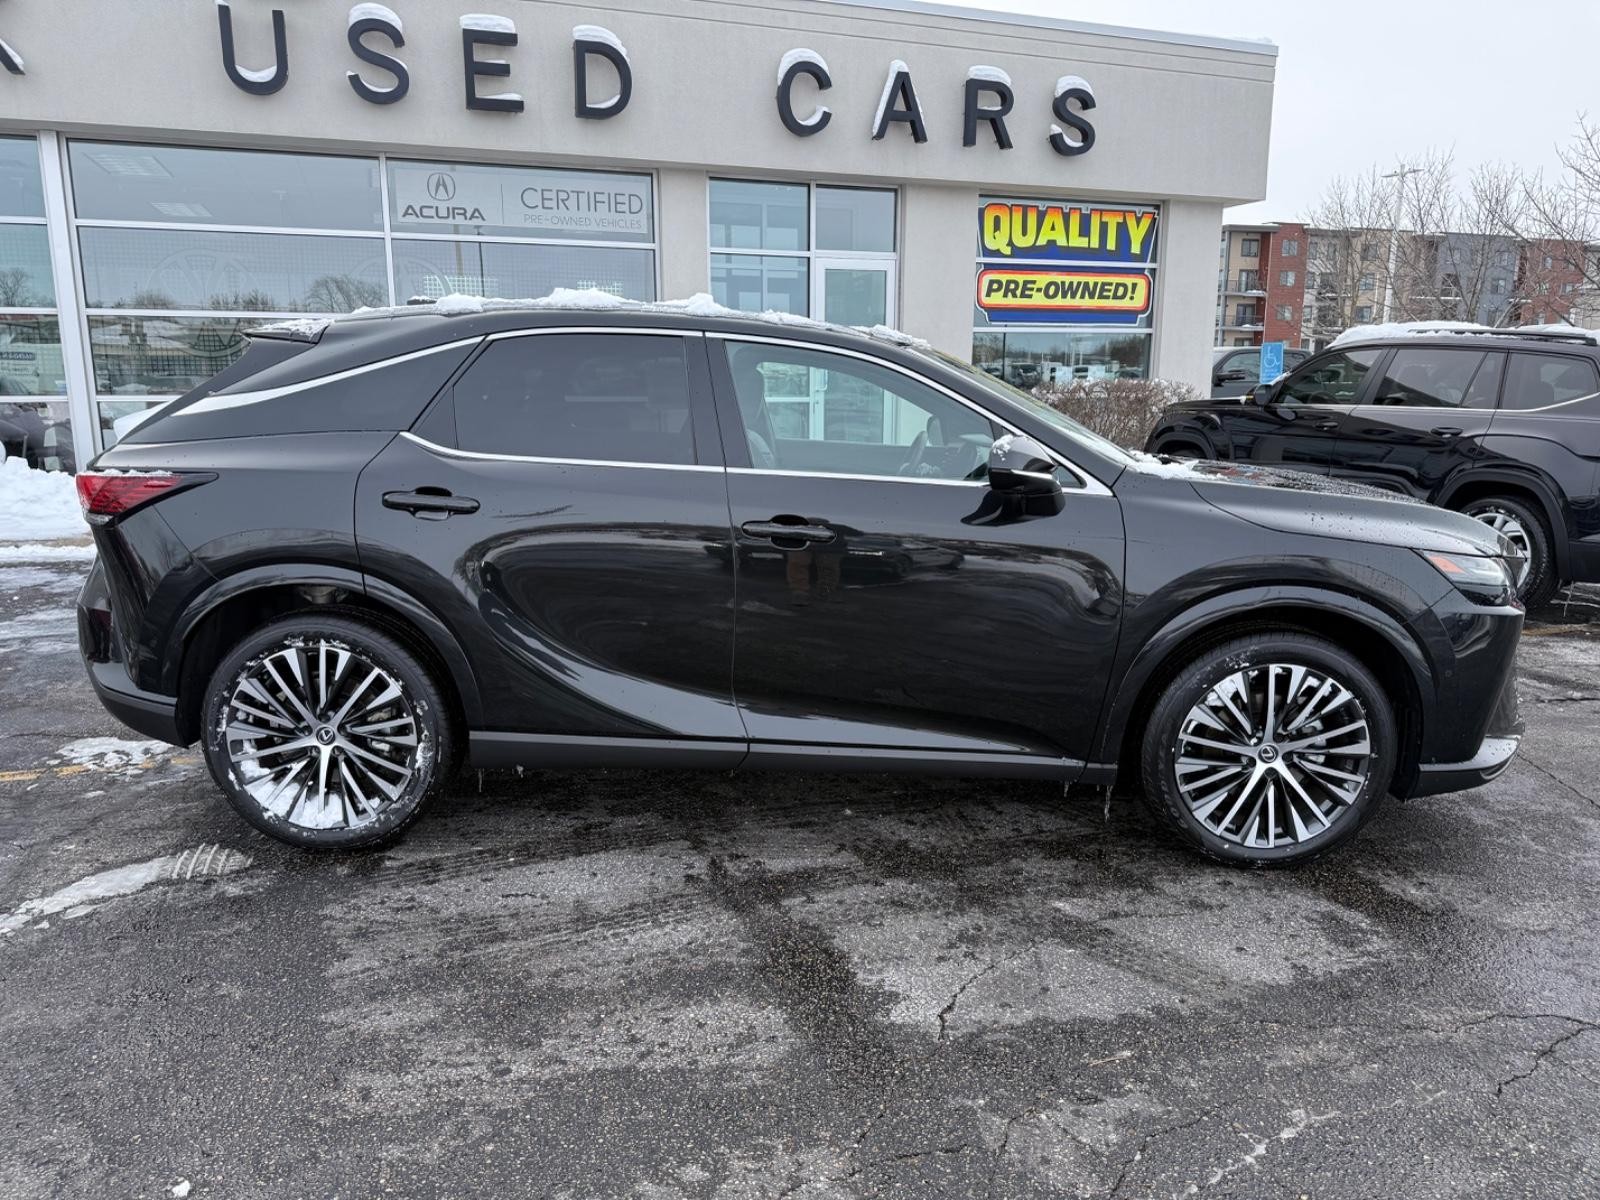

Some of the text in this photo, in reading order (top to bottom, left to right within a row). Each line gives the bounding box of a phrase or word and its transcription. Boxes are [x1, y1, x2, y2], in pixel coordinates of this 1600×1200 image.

[217, 2, 1096, 157] USED CARS
[402, 204, 486, 221] ACURA
[520, 187, 643, 215] CERTIFIED
[523, 214, 643, 229] PRE-OWNED VEHICLES
[983, 202, 1154, 255] QUALITY
[985, 279, 1138, 301] PRE-OWNED!
